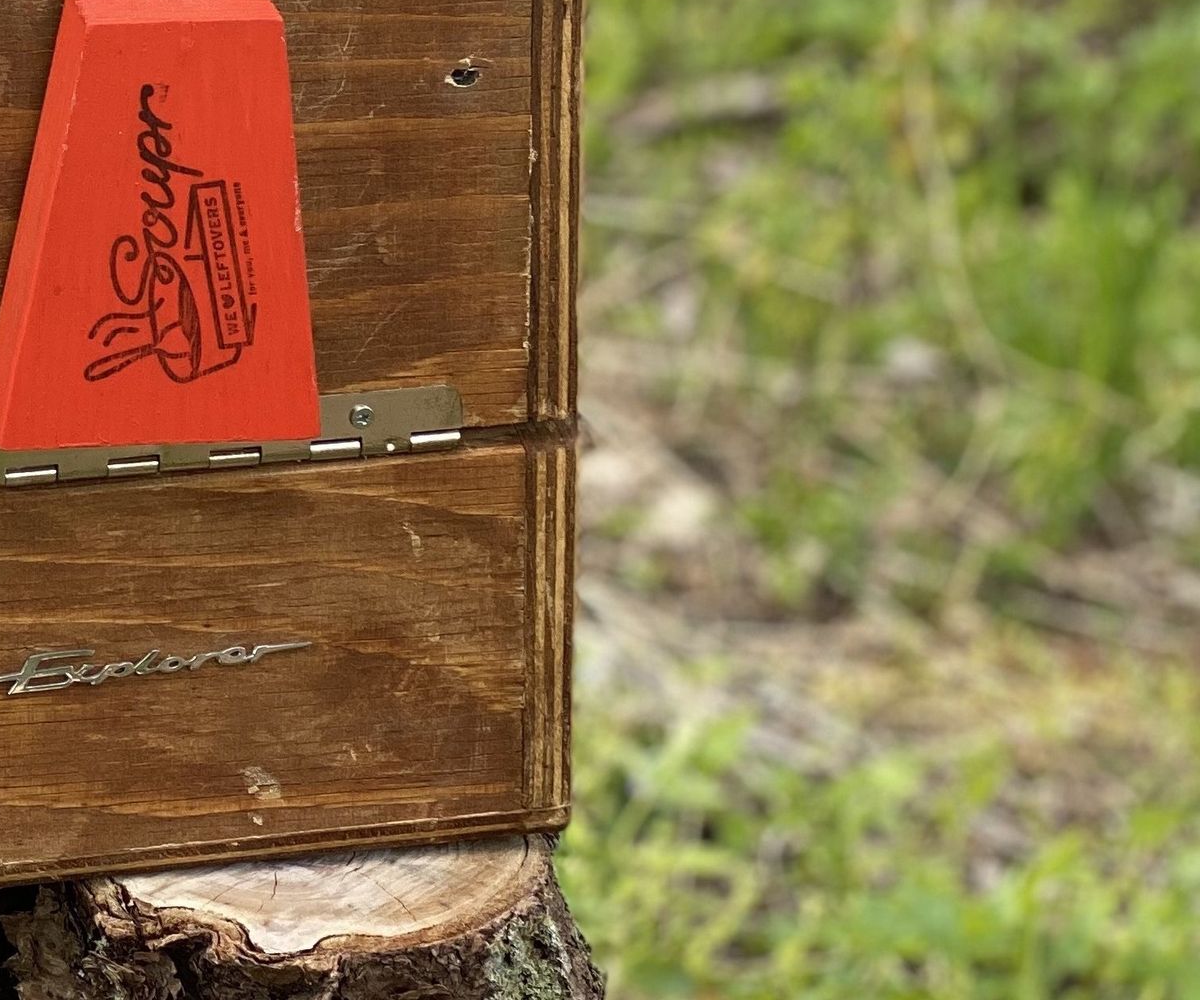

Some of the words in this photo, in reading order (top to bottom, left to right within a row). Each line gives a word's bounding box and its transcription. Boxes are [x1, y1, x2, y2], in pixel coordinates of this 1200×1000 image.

[109, 84, 204, 305] Soupr
[232, 181, 247, 227] everyone
[204, 196, 232, 291] LEFTOVERS
[242, 239, 253, 255] me
[247, 281, 257, 296] for
[225, 310, 241, 336] WE
